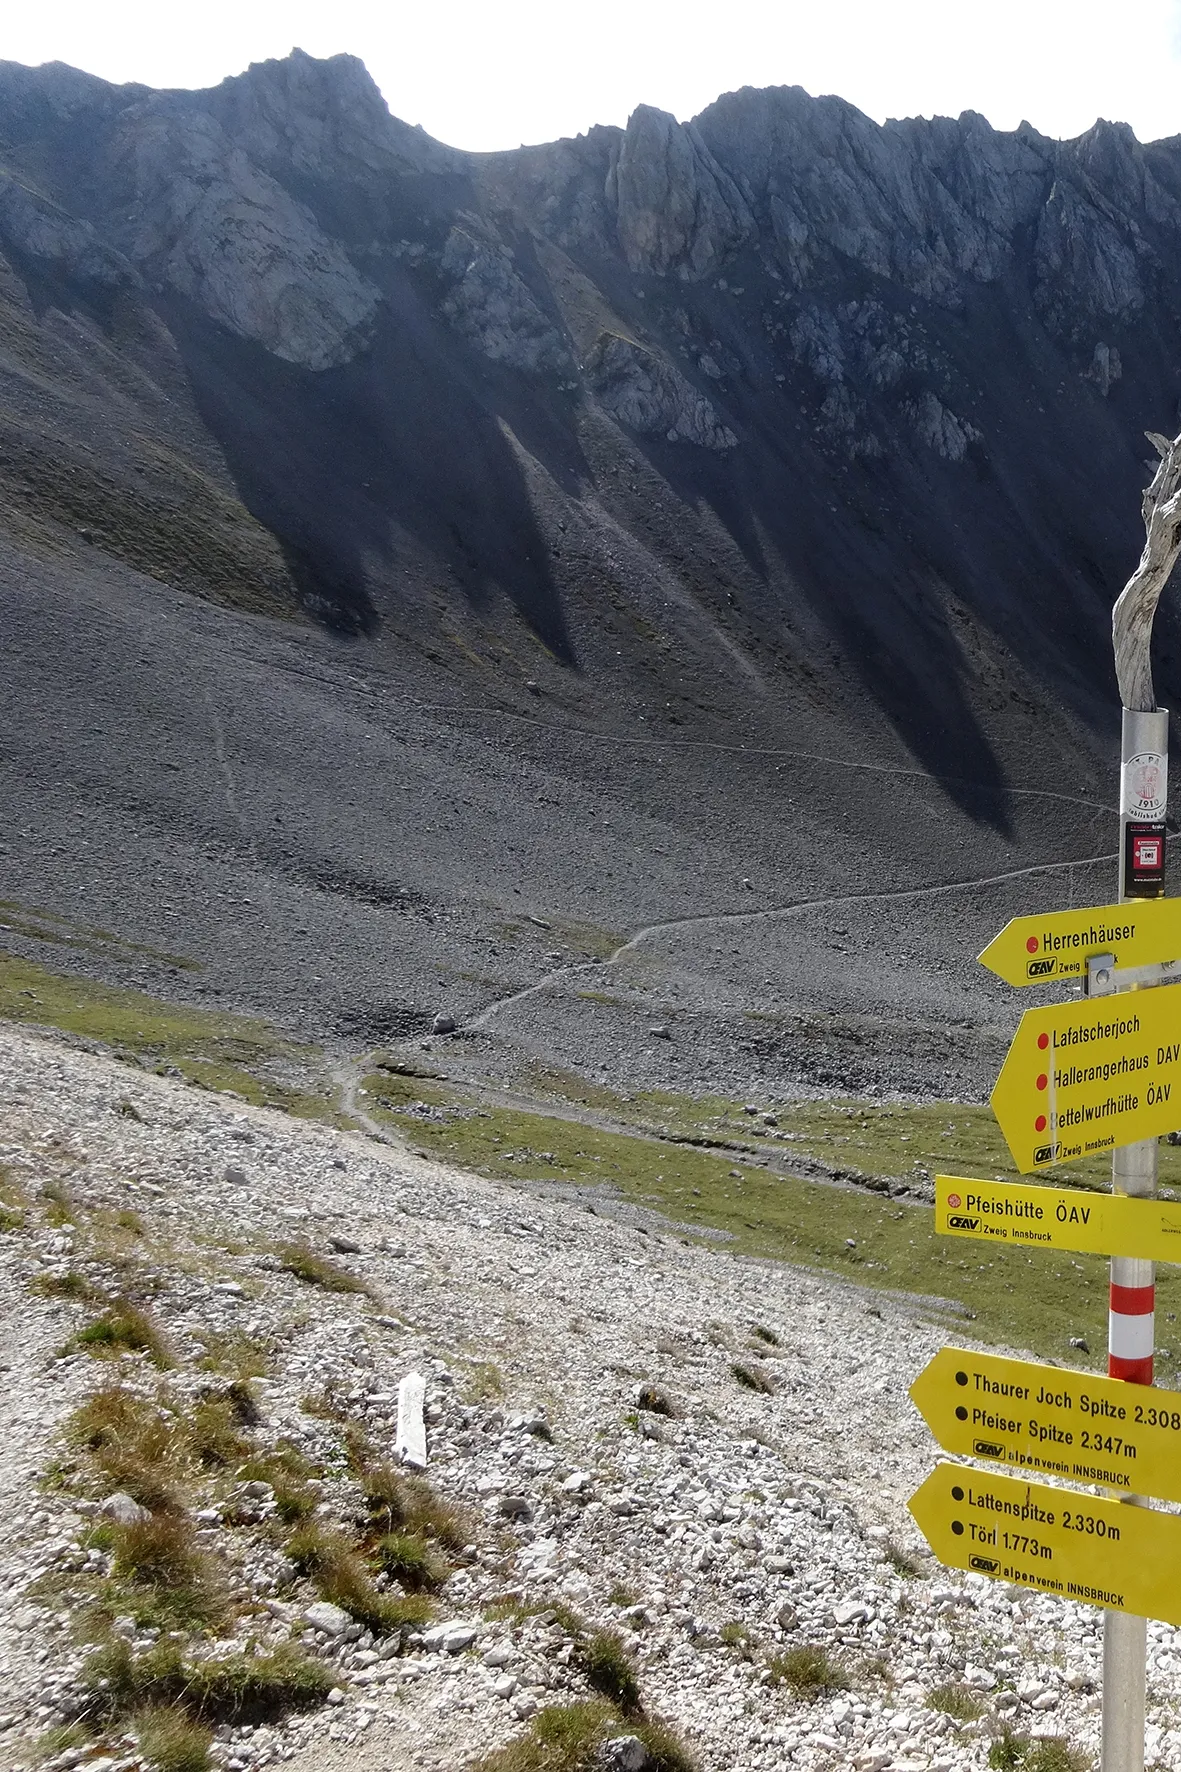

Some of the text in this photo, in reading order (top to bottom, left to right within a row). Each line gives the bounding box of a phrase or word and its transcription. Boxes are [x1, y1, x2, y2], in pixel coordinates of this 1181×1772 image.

[1139, 799, 1160, 808] 1910
[1043, 923, 1136, 952] Herrenhäuser
[1059, 962, 1080, 973] Zweig
[1053, 1014, 1140, 1049] Lafatscherjoch
[1053, 1055, 1149, 1089] Hallerangerhaus
[1157, 1044, 1181, 1066] DAV
[1146, 1082, 1171, 1106] ÖAV
[1063, 1144, 1082, 1157] Zweig
[1085, 1135, 1115, 1151] Innsbruck
[966, 1194, 1044, 1219] Pfeishütte
[1056, 1200, 1091, 1224] ÖAV
[983, 1225, 1008, 1238] Zweig
[1012, 1228, 1052, 1242] Innsbruck
[973, 1373, 1030, 1401] Thaurer
[1036, 1386, 1072, 1409] Joch
[1080, 1395, 1127, 1420] Spitze
[972, 1408, 1022, 1434] Pfeiser
[1028, 1420, 1073, 1445] Spitze
[1081, 1431, 1137, 1459] 2.347m
[1008, 1450, 1069, 1473] alpenverein
[1072, 1464, 1131, 1487] INNSBRUCK
[968, 1489, 1055, 1525] Lattenspitze
[1062, 1511, 1120, 1540] 2.330m
[969, 1523, 997, 1546] Törl
[1002, 1532, 1053, 1560] 1.773m
[1003, 1566, 1064, 1590] alpenverein
[1067, 1582, 1124, 1606] INNSBRUCK
